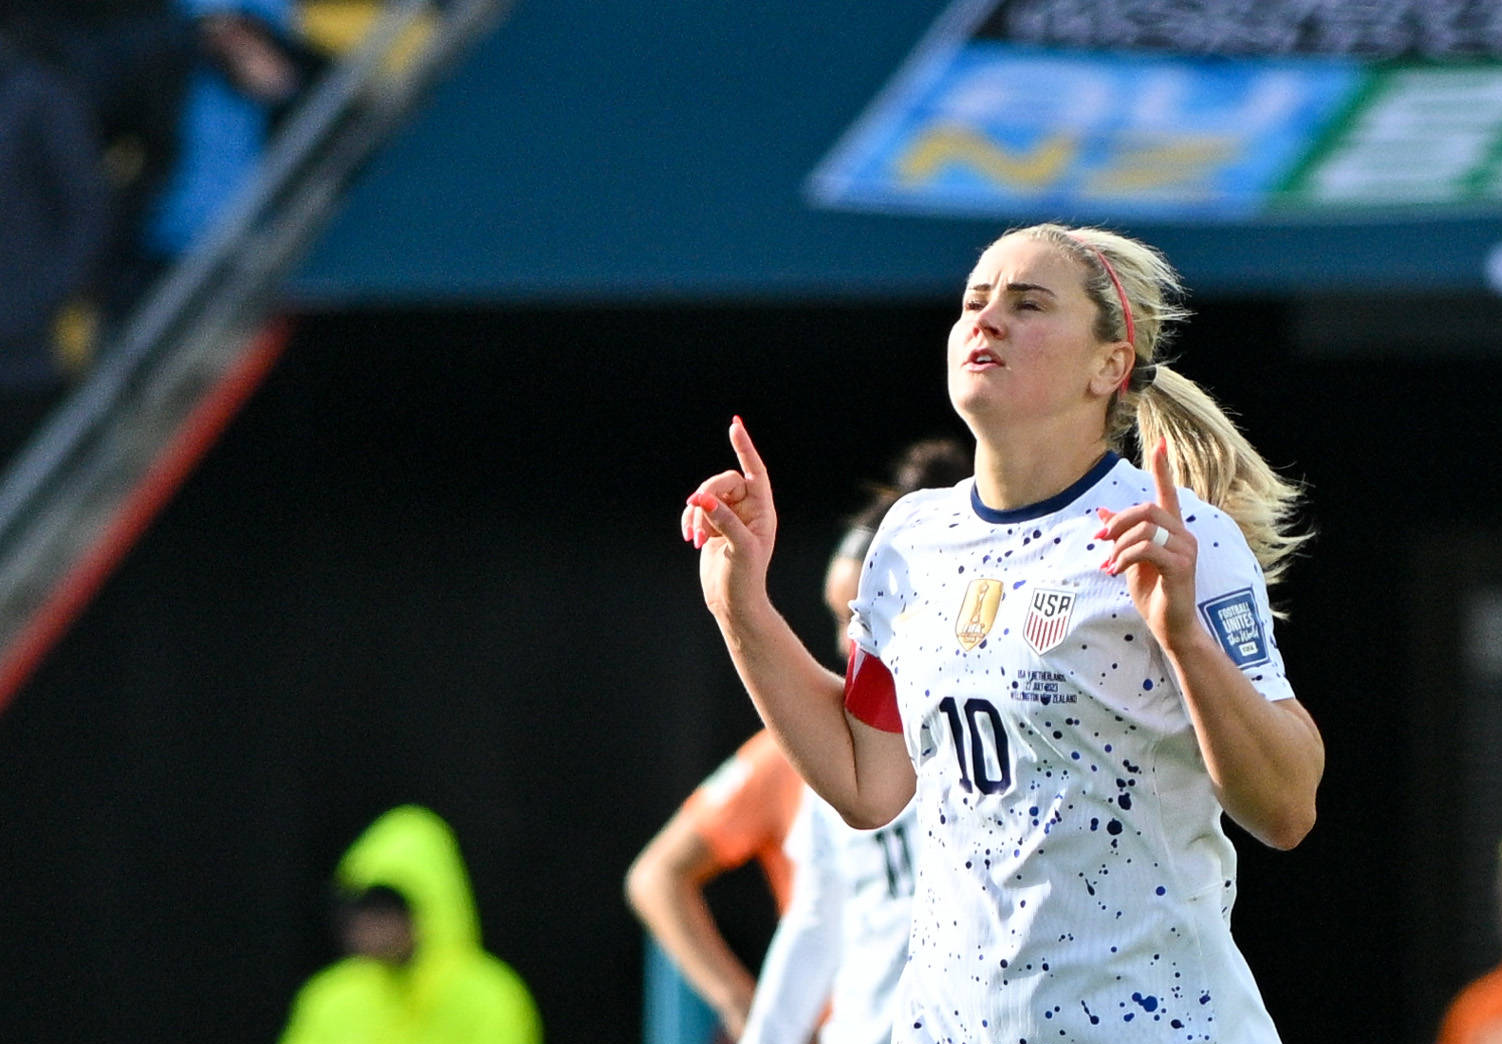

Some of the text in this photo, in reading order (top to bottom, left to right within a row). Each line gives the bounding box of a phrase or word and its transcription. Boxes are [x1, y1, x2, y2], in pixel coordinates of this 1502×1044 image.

[1034, 592, 1072, 618] USA
[1222, 612, 1256, 633] UNITES
[938, 696, 1012, 795] 10
